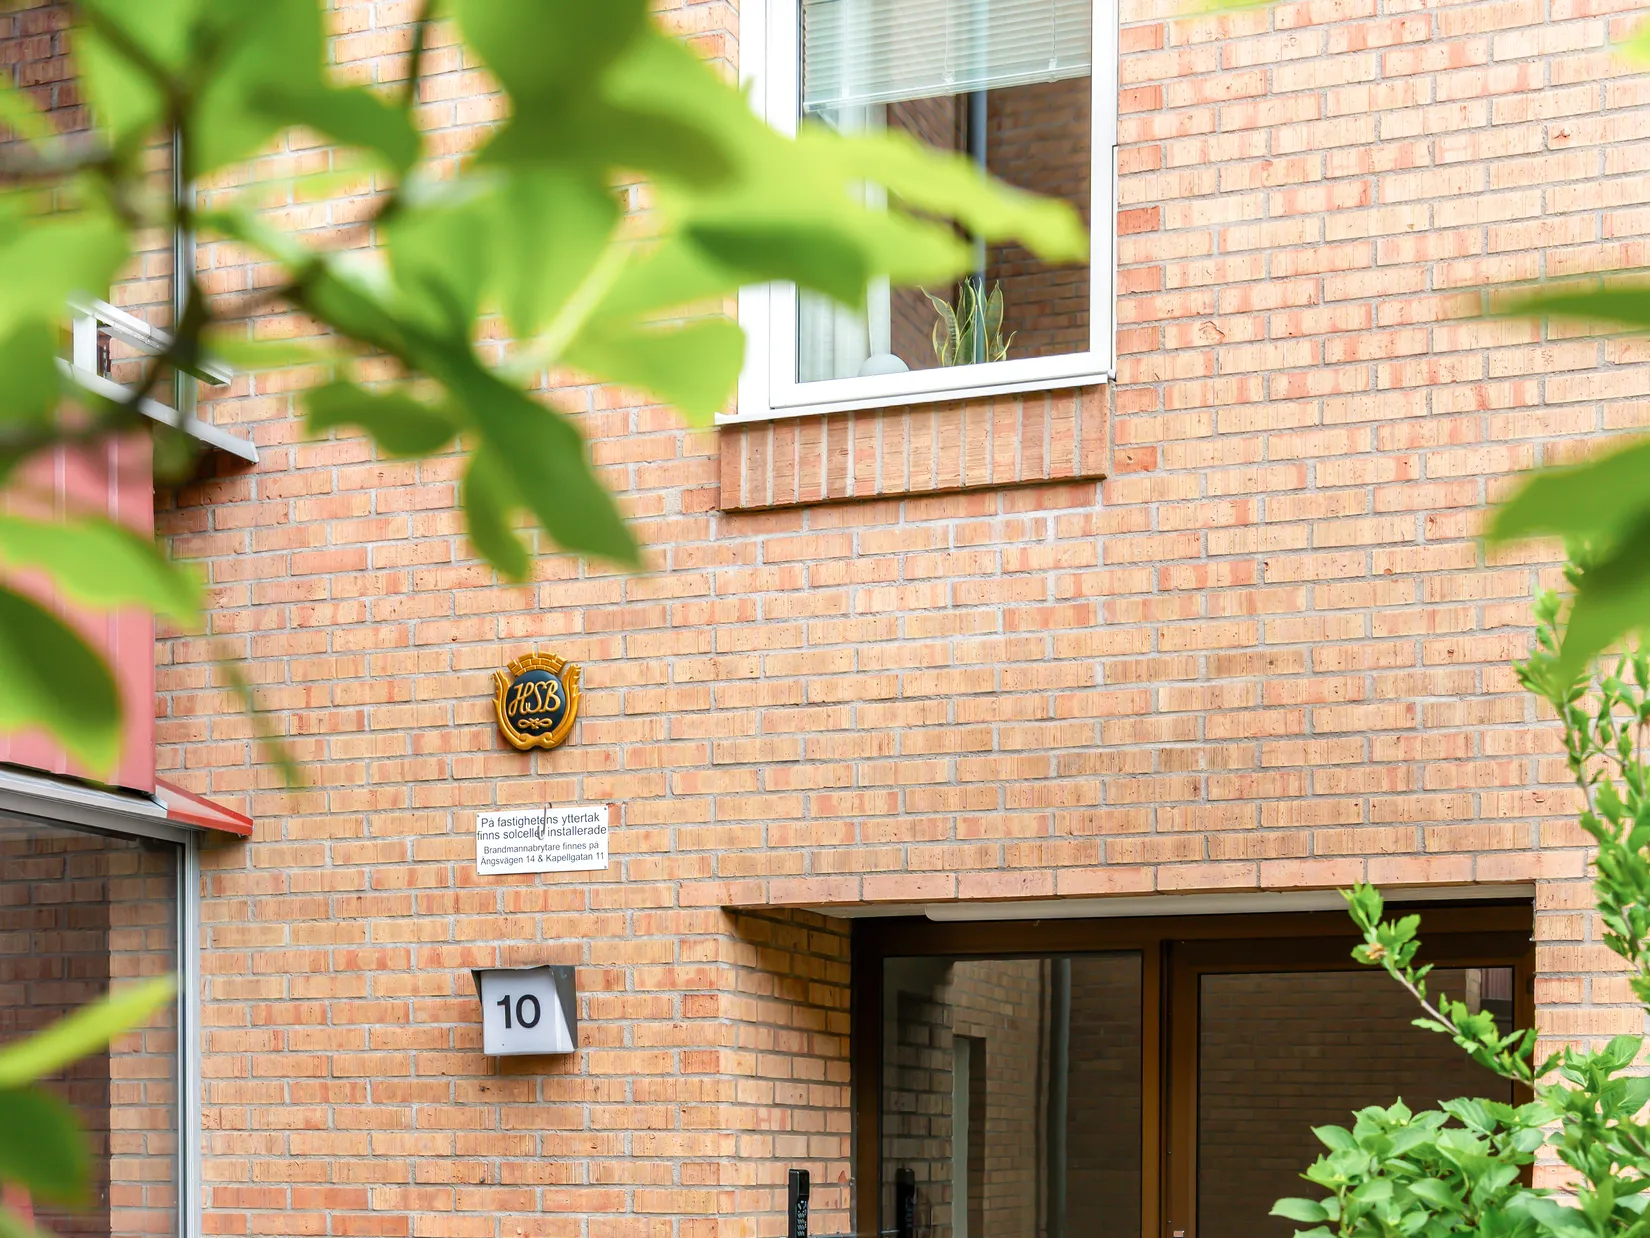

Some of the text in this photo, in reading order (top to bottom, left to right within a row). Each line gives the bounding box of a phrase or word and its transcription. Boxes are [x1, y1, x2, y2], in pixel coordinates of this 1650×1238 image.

[508, 679, 562, 717] HSB
[481, 812, 600, 829] På fastighetens yttertak
[477, 825, 607, 841] finns solceller installerade
[484, 841, 599, 854] Brandmannabrytare finnes på
[538, 854, 544, 862] &
[546, 853, 593, 863] Kapellgatan
[596, 852, 604, 860] 11
[496, 993, 541, 1029] 10
